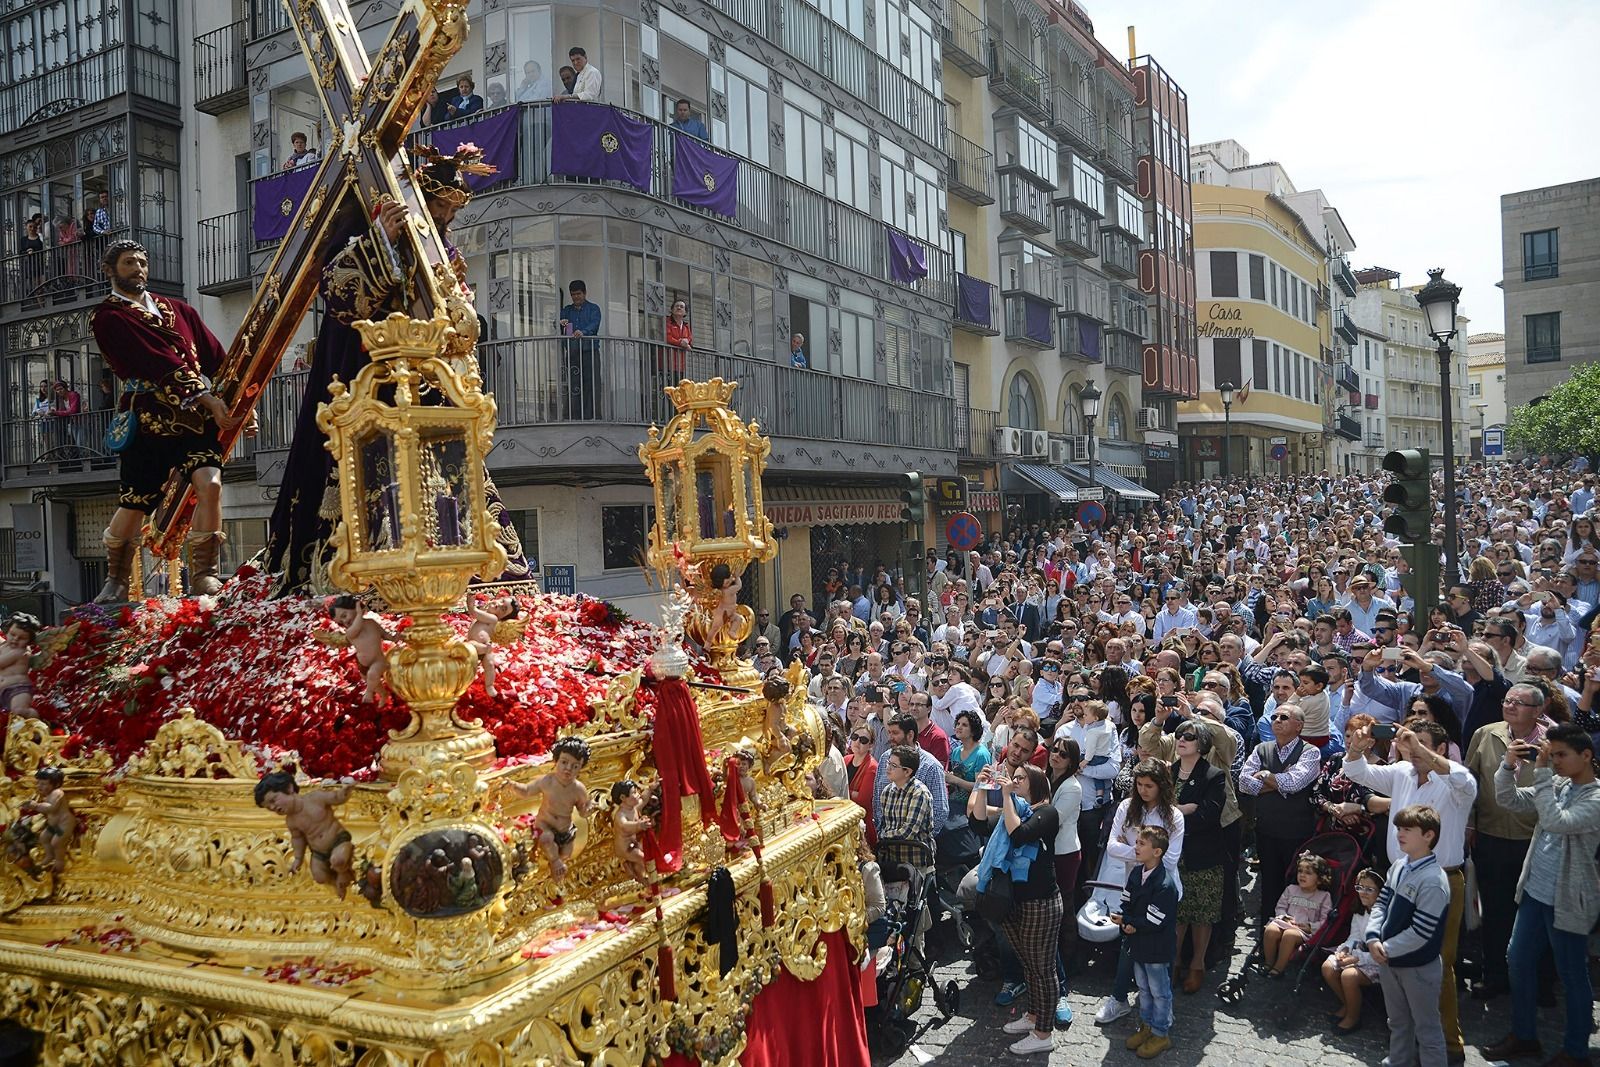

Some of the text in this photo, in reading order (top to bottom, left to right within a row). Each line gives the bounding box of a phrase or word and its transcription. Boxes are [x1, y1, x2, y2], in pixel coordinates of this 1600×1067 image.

[1209, 303, 1242, 320] Casa
[1197, 321, 1255, 339] Almansa
[765, 506, 813, 523] ONEDA
[817, 503, 874, 521] SAGITARIO
[554, 568, 569, 576] Calle
